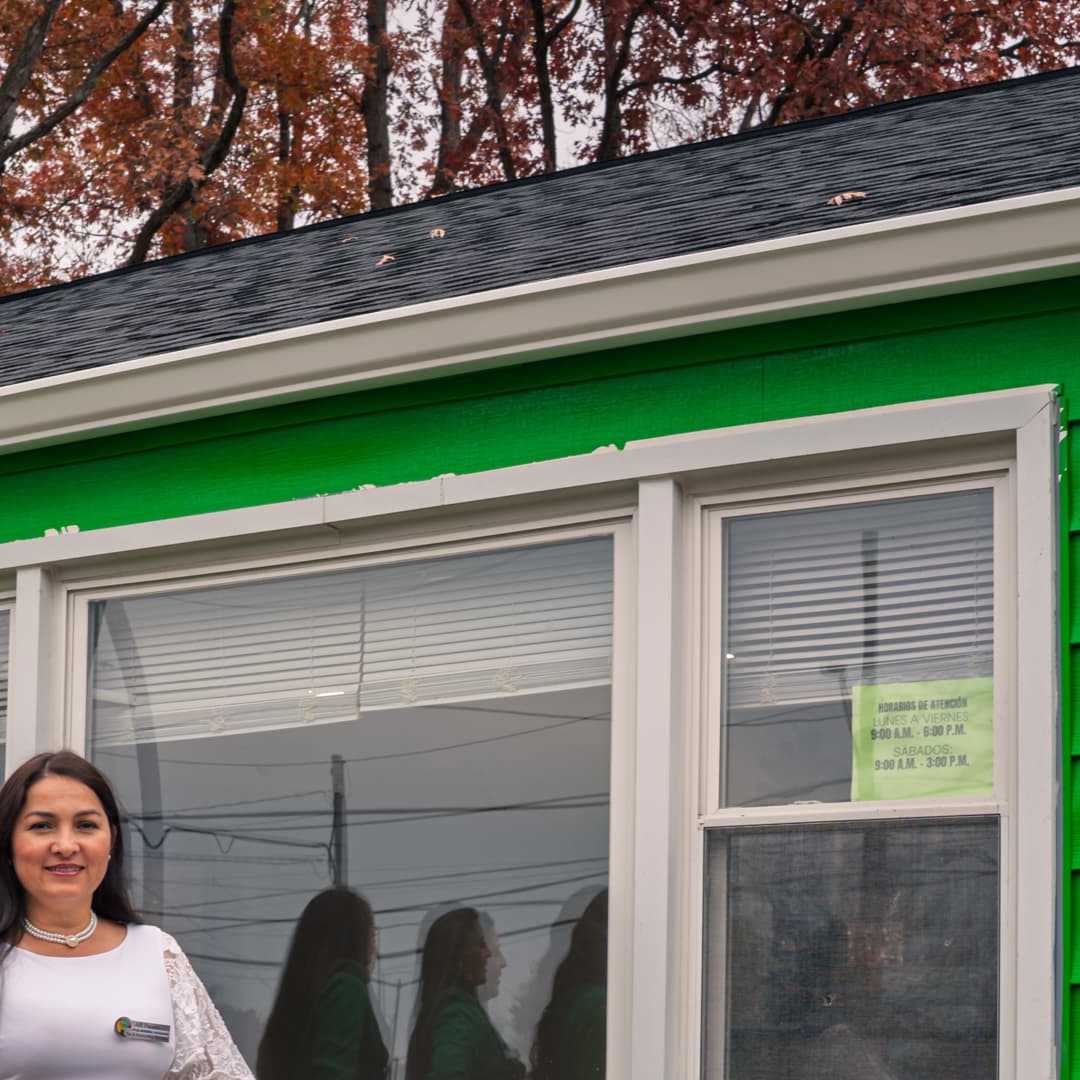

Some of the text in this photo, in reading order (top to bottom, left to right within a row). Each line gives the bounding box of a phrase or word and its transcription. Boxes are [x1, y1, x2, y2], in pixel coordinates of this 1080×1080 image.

[918, 700, 928, 710] DE
[873, 711, 968, 727] LUNES A VIERNES
[871, 728, 891, 740] 9:00
[894, 727, 914, 739] A.M.
[923, 725, 944, 737] 6:00
[946, 723, 967, 736] P.M.
[875, 759, 895, 771] 9:00
[897, 758, 917, 770] A.M.
[926, 756, 947, 769] 3:00
[949, 754, 970, 767] P.M.
